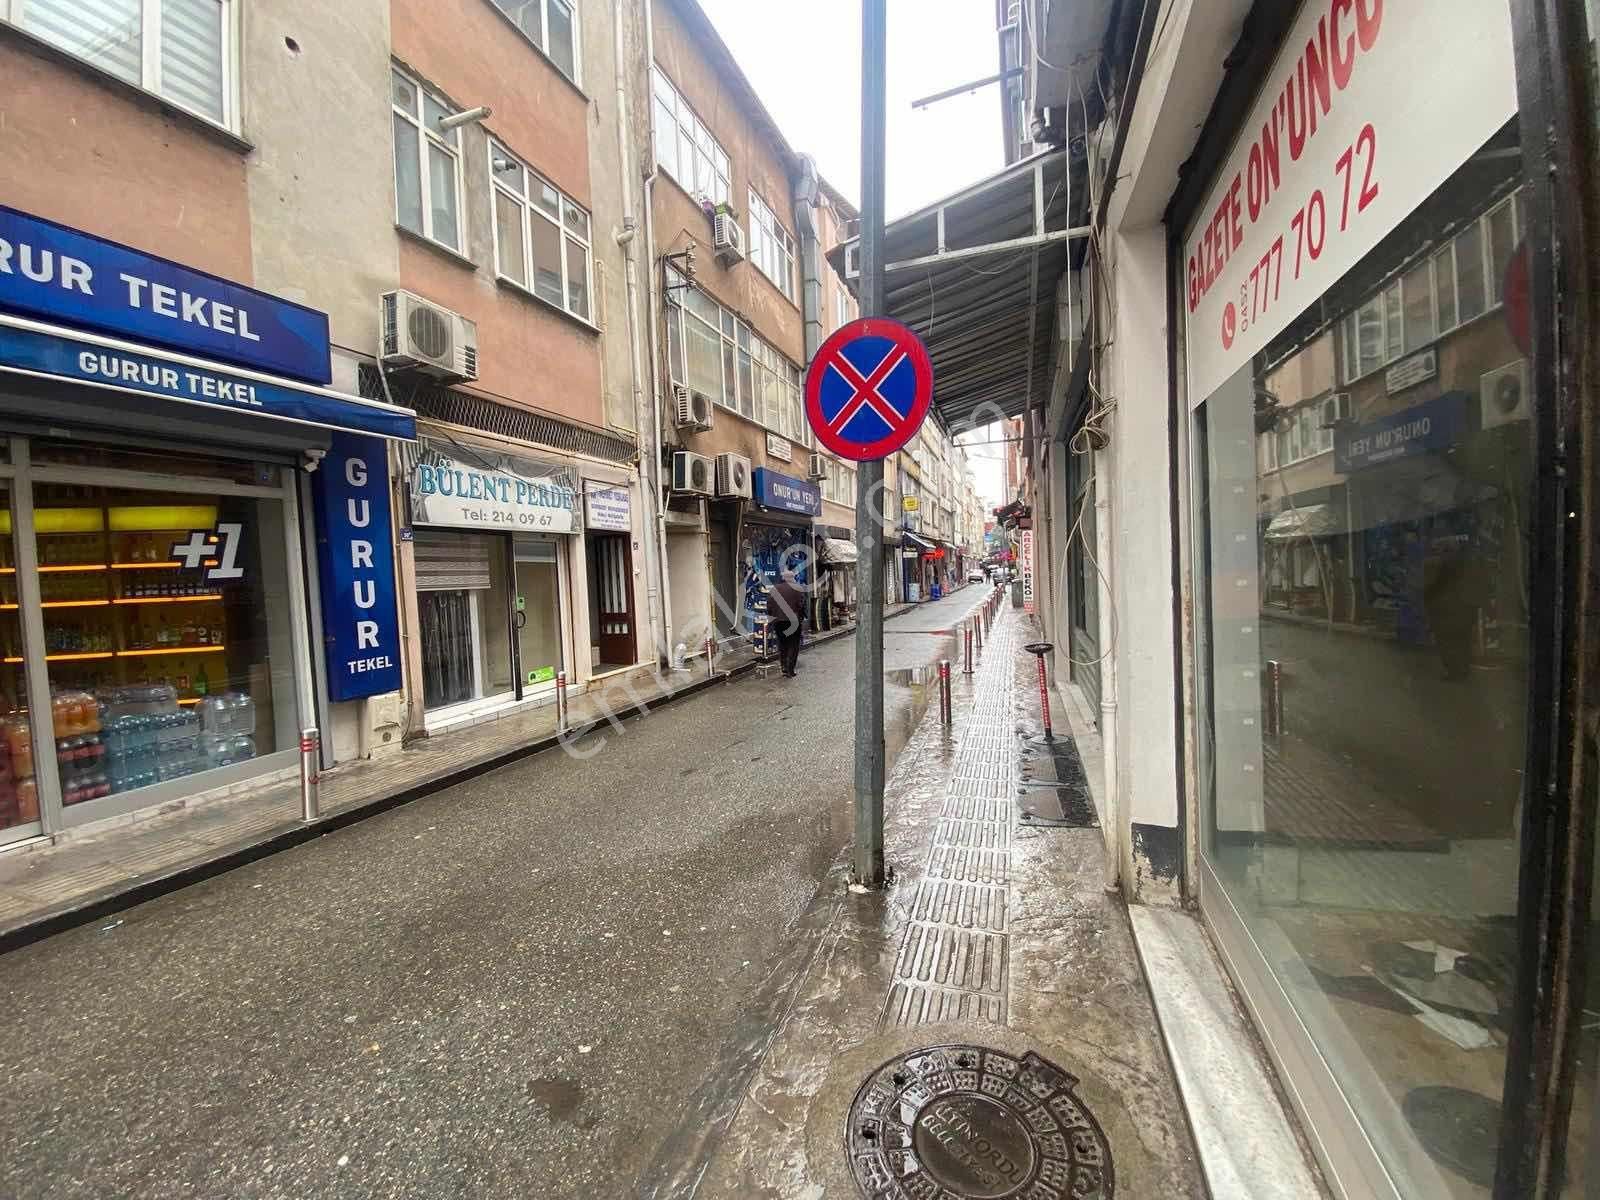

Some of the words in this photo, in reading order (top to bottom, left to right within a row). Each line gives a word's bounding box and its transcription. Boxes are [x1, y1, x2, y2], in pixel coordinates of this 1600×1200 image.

[1187, 172, 1244, 314] GAZETE
[1249, 234, 1283, 325] 777
[1291, 189, 1326, 280] 70
[1335, 123, 1379, 232] 72
[119, 272, 261, 342] TEKEL
[79, 350, 180, 389] GURUR
[184, 372, 263, 407] TEKEL
[418, 458, 513, 504] BÜLENT
[514, 477, 573, 511] PERDE
[461, 507, 487, 522] Tel:
[492, 510, 515, 524] 214
[519, 512, 536, 526] 09
[539, 514, 553, 527] 67
[344, 456, 380, 650] GURUR
[347, 656, 393, 676] TEKEL
